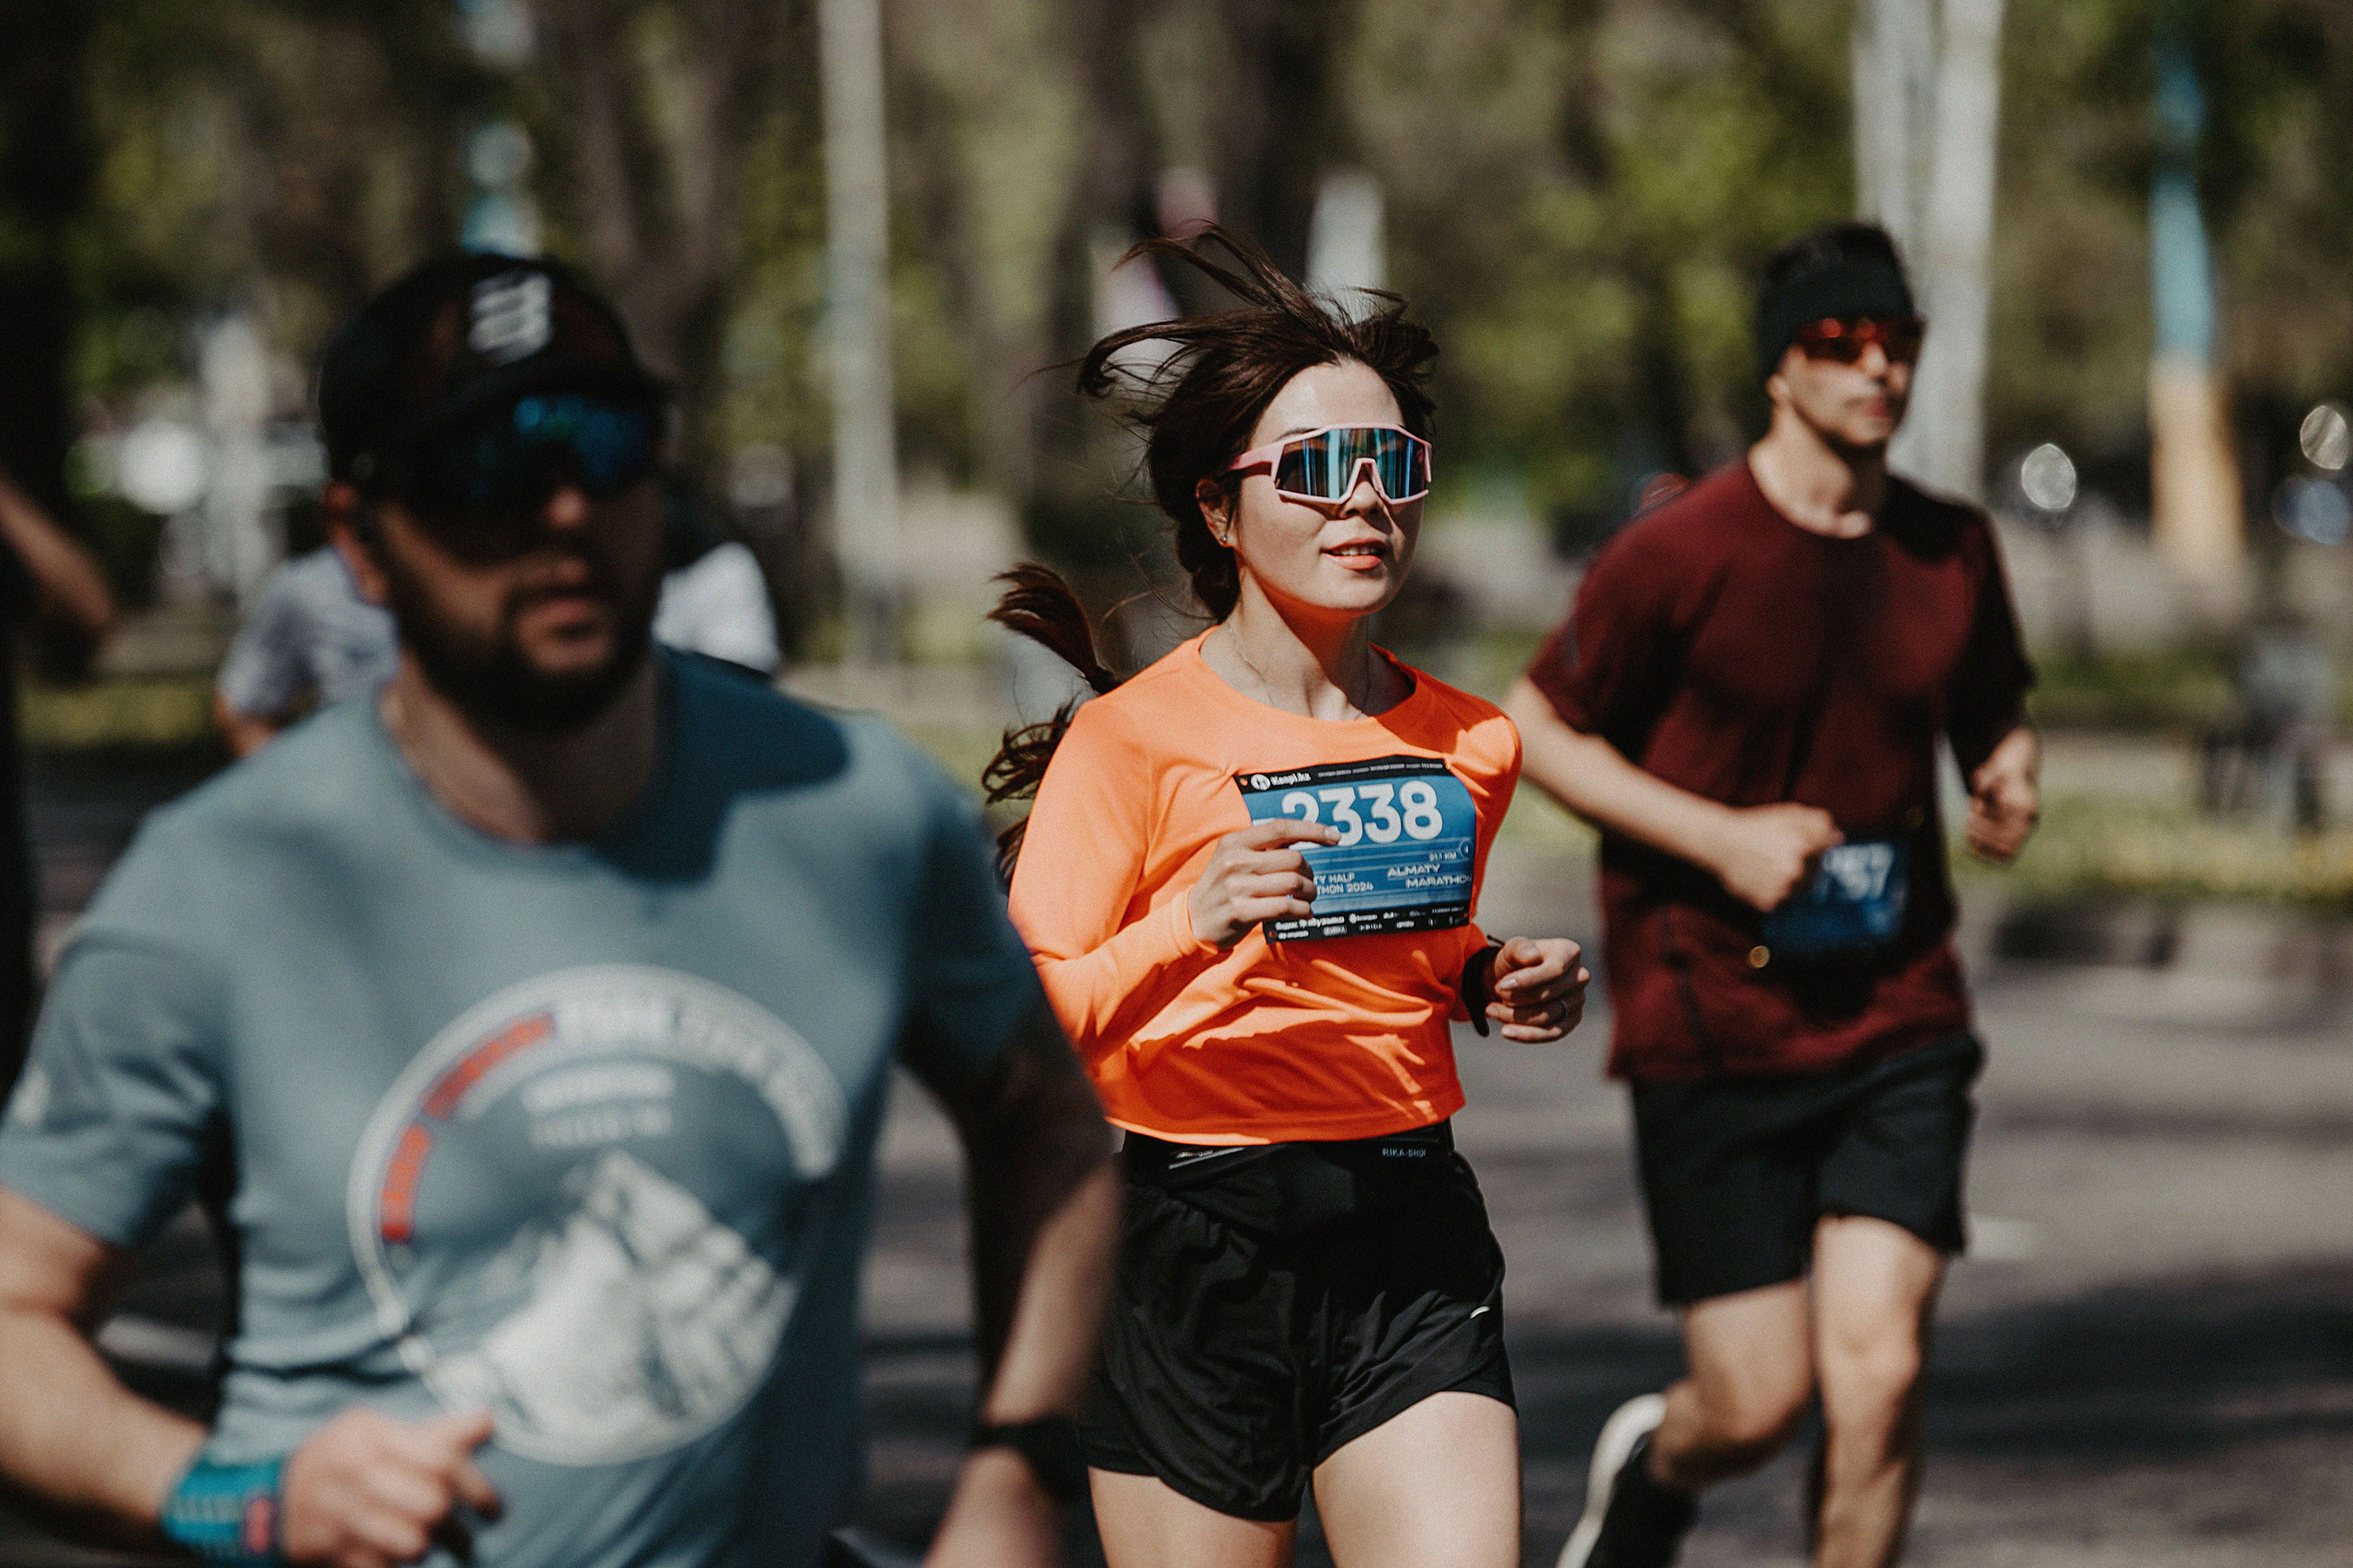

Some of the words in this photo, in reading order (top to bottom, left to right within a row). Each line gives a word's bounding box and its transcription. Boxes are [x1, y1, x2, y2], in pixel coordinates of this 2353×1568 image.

[1281, 779, 1443, 850] 2338
[1444, 851, 1457, 860] KM
[1328, 872, 1356, 883] HALF
[1387, 863, 1440, 878] ALMATY
[1317, 884, 1344, 895] THON
[1346, 881, 1374, 892] 2024
[1405, 875, 1472, 889] MARATHON
